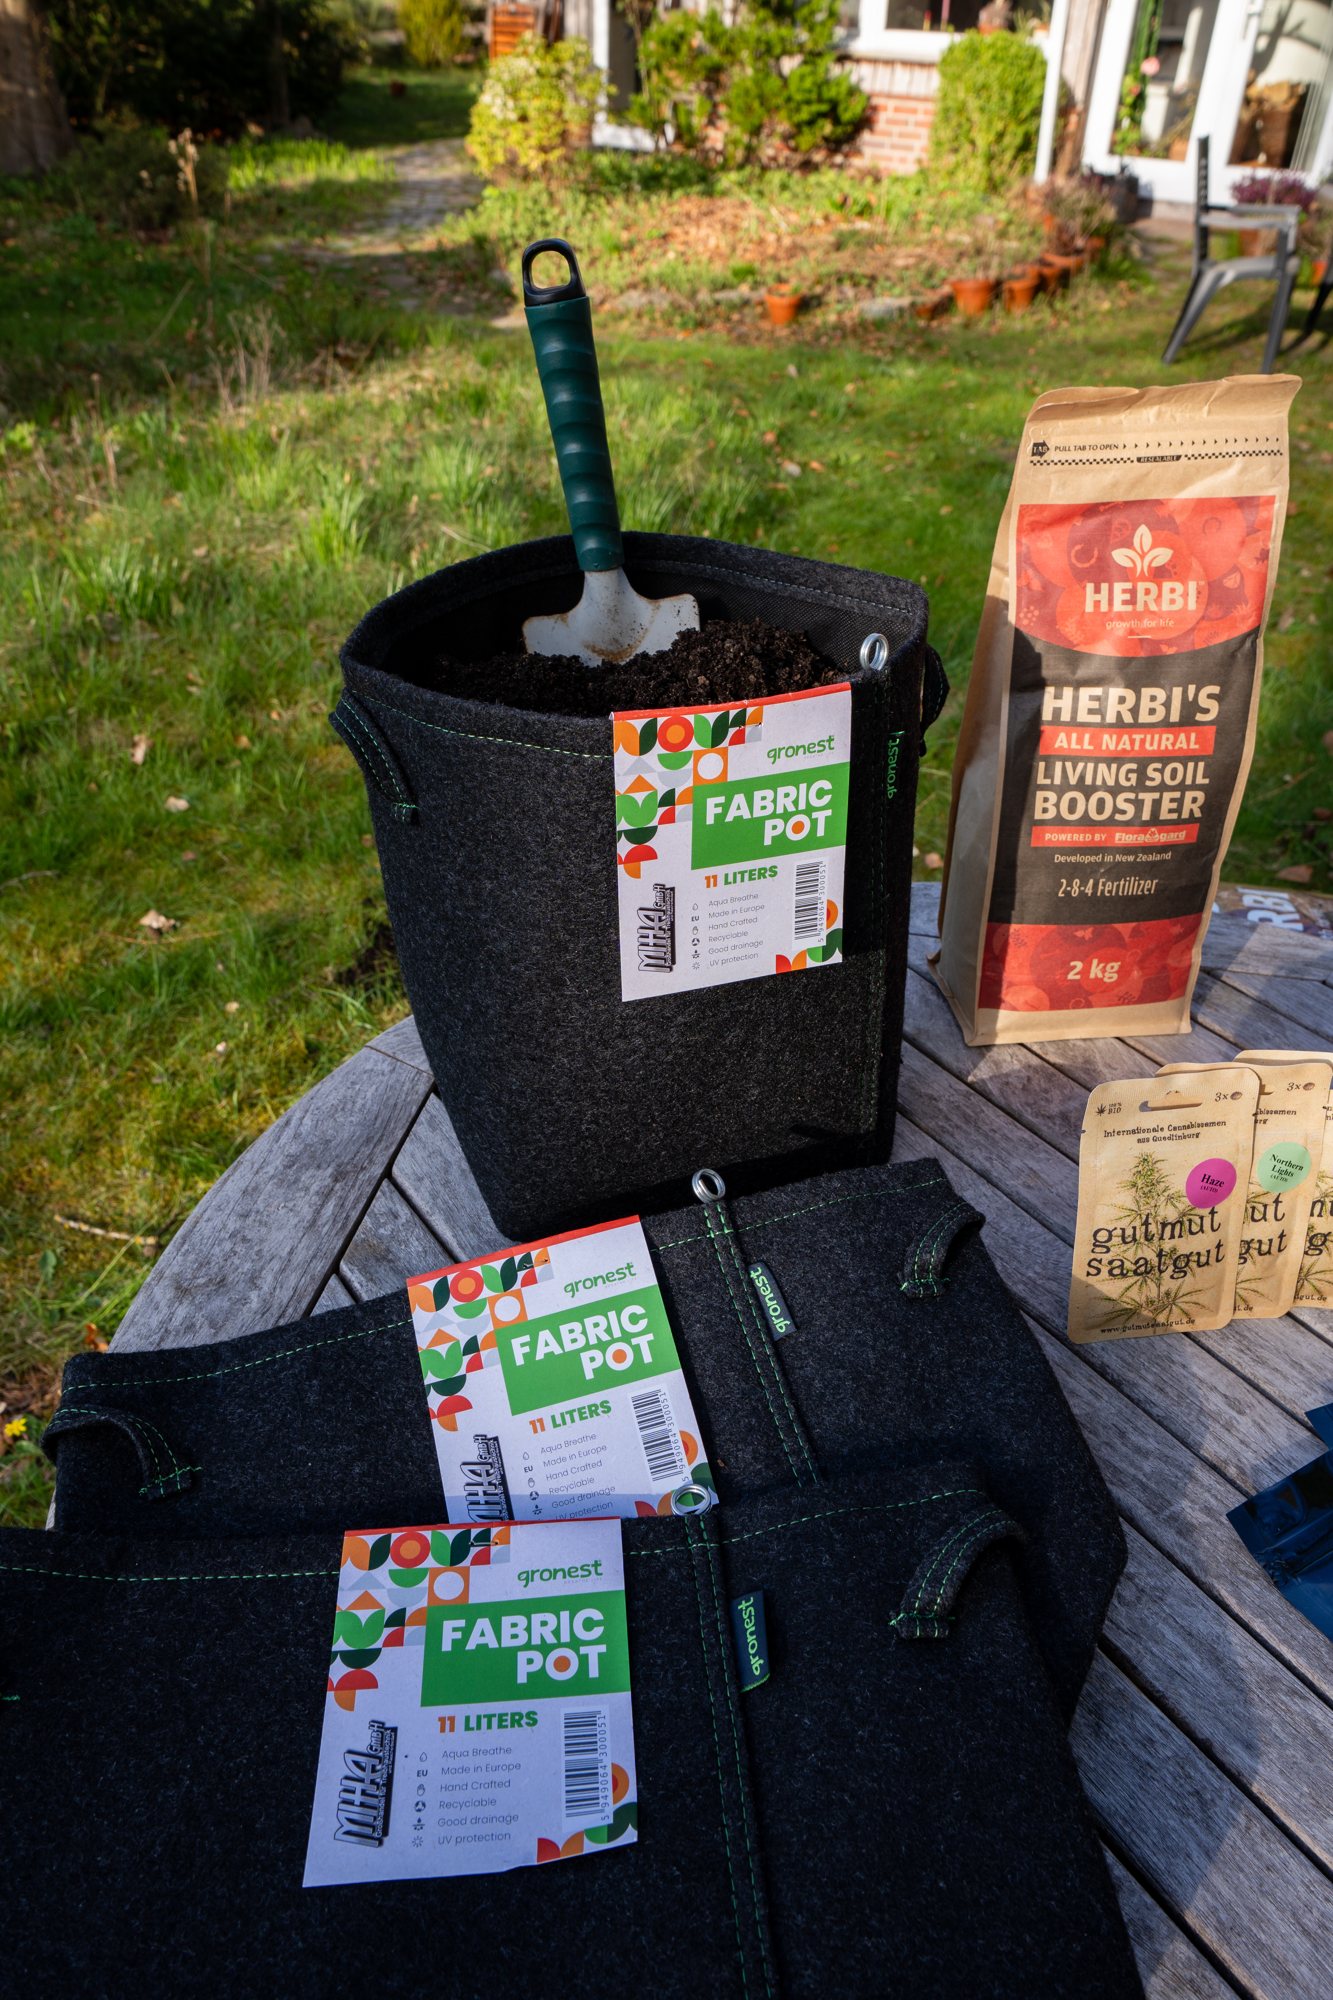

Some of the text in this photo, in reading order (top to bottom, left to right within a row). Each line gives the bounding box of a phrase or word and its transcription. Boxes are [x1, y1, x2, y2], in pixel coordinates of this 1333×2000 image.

[1085, 581, 1197, 613] HERBI
[1106, 618, 1174, 630] growth for life
[1041, 684, 1221, 724] HERBI'S
[767, 735, 835, 765] gronest
[1054, 732, 1200, 752] ALL NATURAL
[887, 738, 900, 799] gronest
[1036, 761, 1210, 787] LIVING SOIL
[705, 779, 833, 825] FABRIC
[1034, 790, 1206, 821] BOOSTER
[763, 810, 832, 846] POT
[1045, 833, 1093, 841] POWERED
[1094, 833, 1106, 841] BY
[1054, 851, 1172, 864] Developed in New Zealand
[704, 865, 778, 889] 11 LITERS
[1058, 876, 1159, 897] 2-8-4 Fertilizer
[708, 894, 758, 907] Aqua Breathe
[708, 910, 730, 918] Made
[740, 904, 764, 914] Europe
[708, 917, 758, 930] Hand Crafted
[708, 930, 748, 942] Recyclable
[708, 940, 764, 954] Good drainage
[722, 953, 758, 966] protection
[1066, 958, 1121, 983] 2 kg
[1214, 1092, 1229, 1102] 3x
[1286, 1082, 1302, 1092] 3x
[1104, 1124, 1164, 1138] Internationale
[1270, 1154, 1304, 1172] Northern
[1271, 1165, 1294, 1178] Lights
[1201, 1174, 1225, 1188] Haze
[1092, 1206, 1222, 1254] gutmut
[1086, 1242, 1225, 1280] saatgut
[564, 1262, 636, 1298] gronest
[750, 1267, 791, 1332] gronest
[510, 1304, 649, 1367] FABRIC
[580, 1334, 655, 1381] POT
[529, 1400, 612, 1435] 11 LITERS
[540, 1434, 597, 1454] Aqua Breathe
[543, 1456, 567, 1468] Made
[578, 1444, 607, 1458] Europe
[546, 1460, 603, 1480] Hand Crafted
[549, 1476, 595, 1494] Recyclable
[552, 1486, 616, 1508] Good drainage
[570, 1501, 614, 1520] protection
[518, 1560, 604, 1588] gronest
[441, 1608, 605, 1653] FABRIC
[738, 1596, 764, 1676] gronest
[516, 1644, 607, 1684] POT
[438, 1710, 538, 1734] 11 LITERS
[442, 1746, 512, 1760] Aqua Breathe
[442, 1765, 470, 1775] Made
[486, 1763, 522, 1772] Europe
[440, 1779, 510, 1792] Hand Crafted
[439, 1798, 496, 1810] Recyclable
[438, 1814, 519, 1828] Good drainage
[438, 1832, 511, 1846] UV protection
